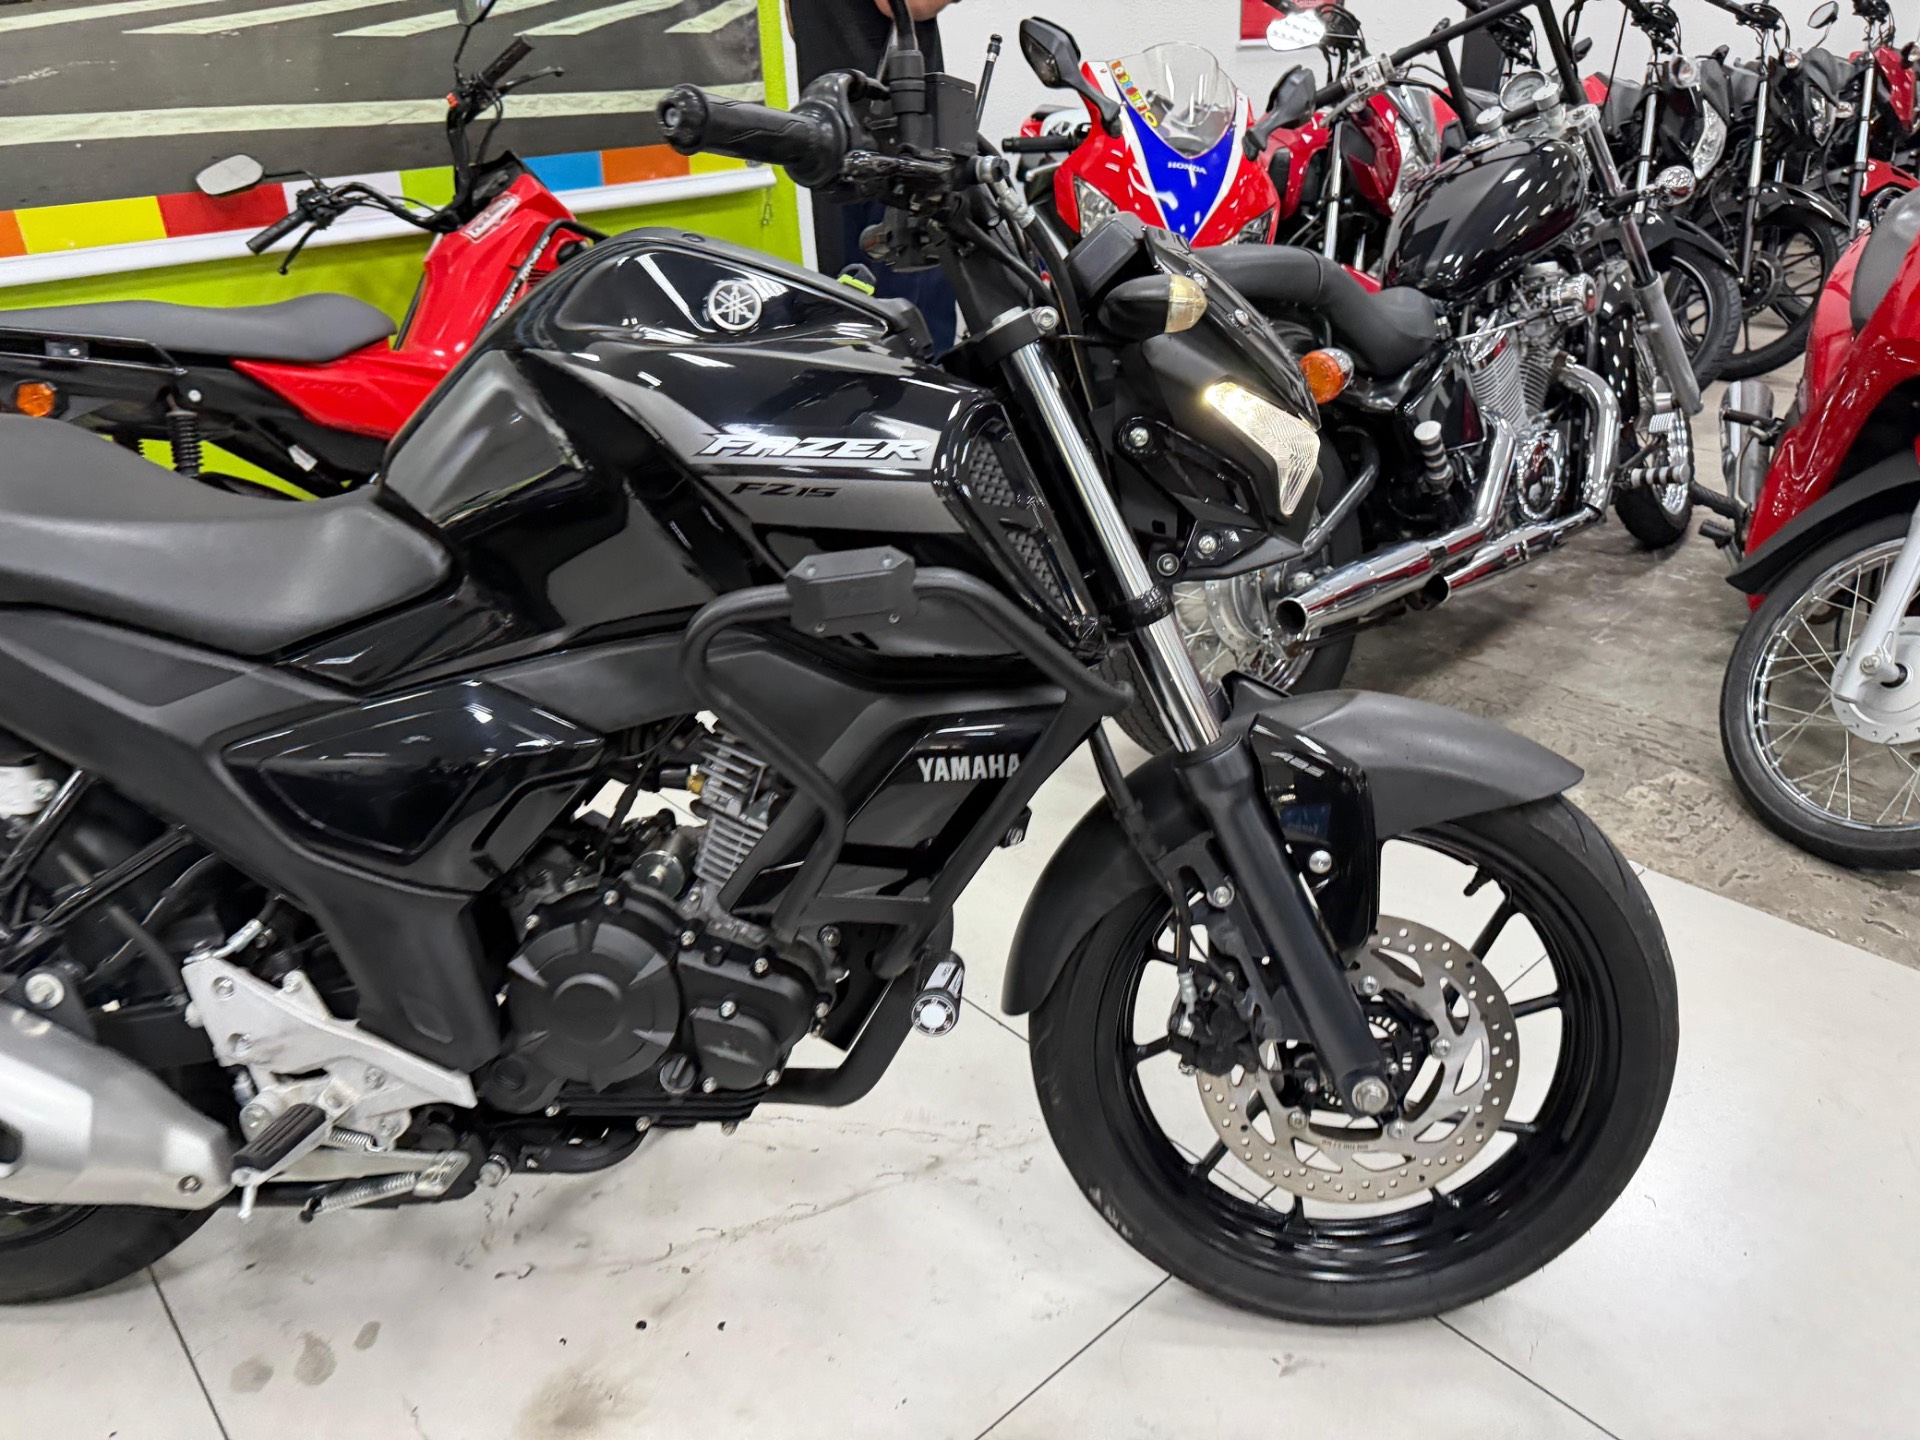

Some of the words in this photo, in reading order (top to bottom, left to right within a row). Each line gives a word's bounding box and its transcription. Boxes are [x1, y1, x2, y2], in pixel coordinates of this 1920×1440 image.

[1167, 161, 1208, 175] HONDA
[692, 433, 931, 461] FAZER
[730, 482, 842, 498] FZ15
[917, 753, 1020, 782] YAMAHA
